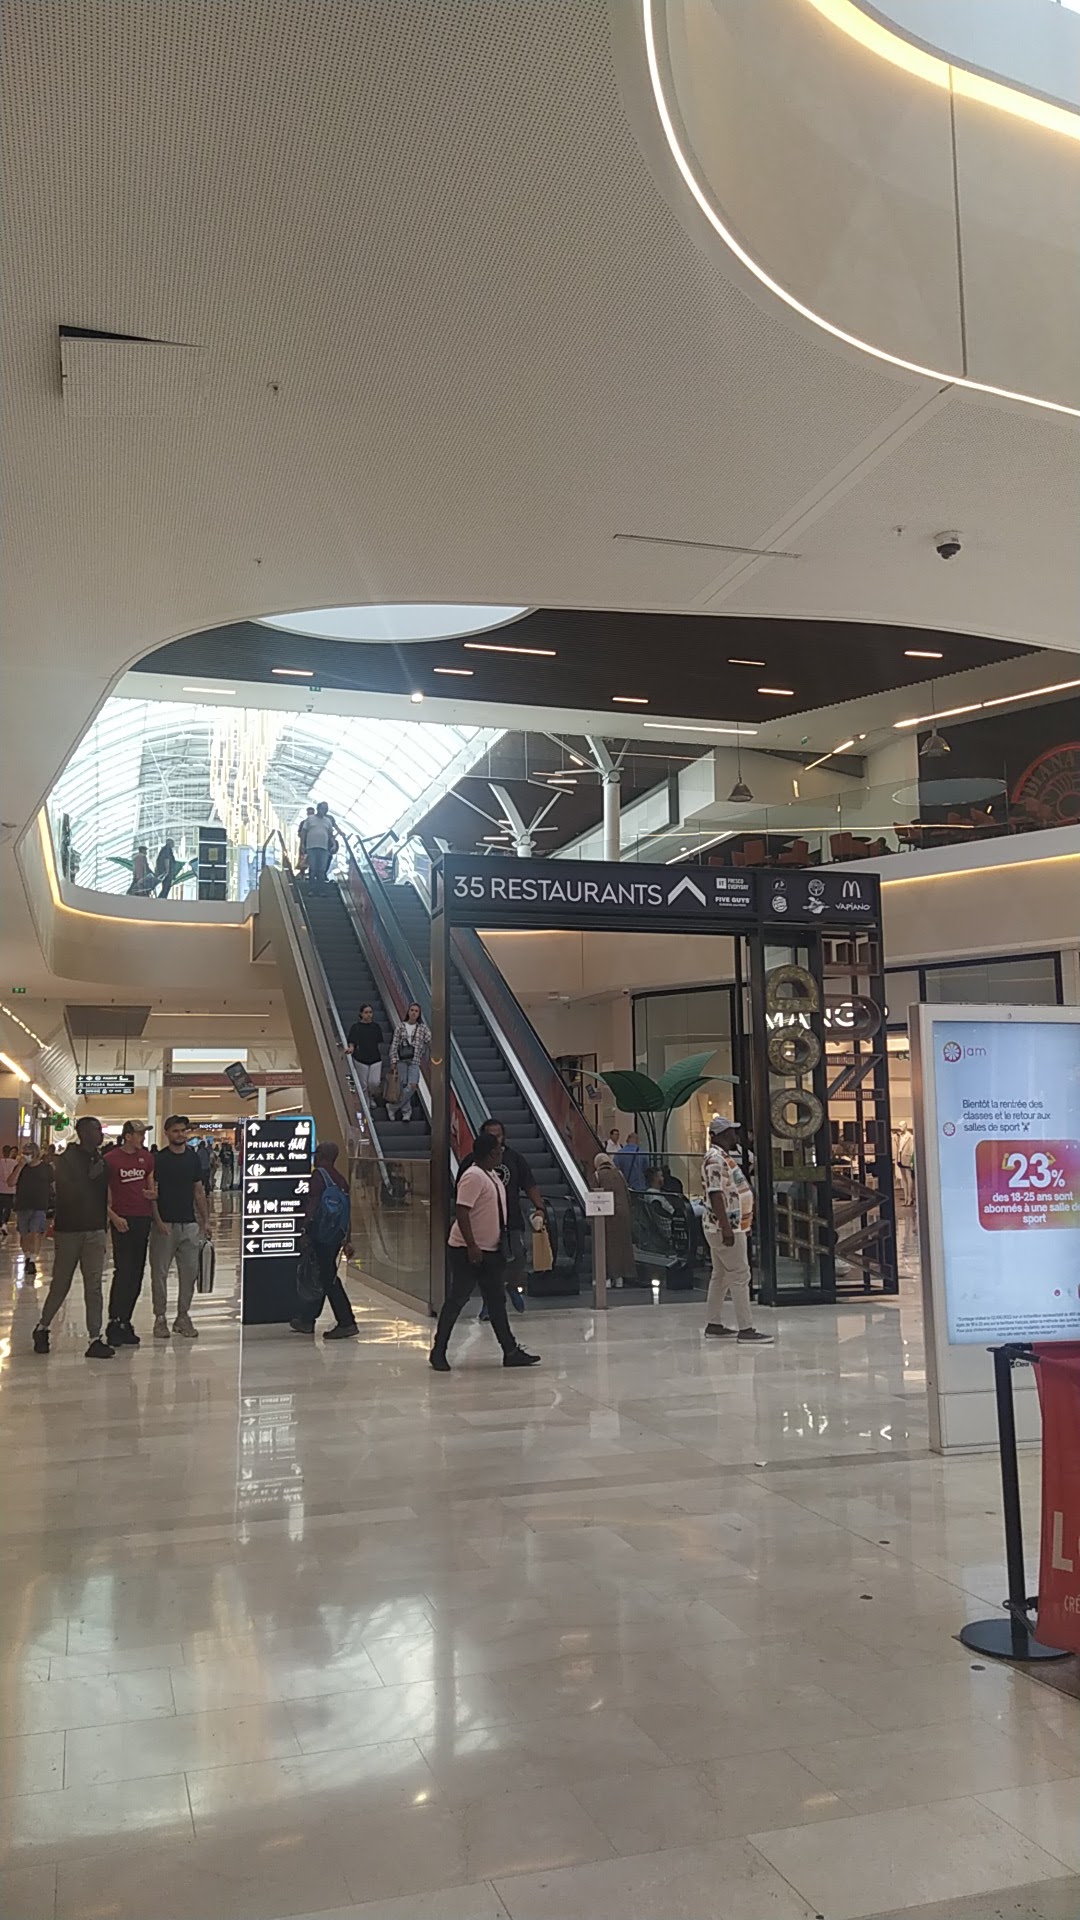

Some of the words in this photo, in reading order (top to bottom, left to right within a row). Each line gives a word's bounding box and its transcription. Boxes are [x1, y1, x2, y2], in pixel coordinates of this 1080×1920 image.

[453, 875, 485, 899] 35
[490, 876, 663, 906] RESTAURANTS
[835, 902, 871, 911] VAPIANO
[963, 1044, 987, 1058] jam
[962, 1099, 990, 1109] Bientôt
[991, 1100, 999, 1109] la
[1000, 1100, 1028, 1109] rentrée
[1028, 1100, 1044, 1109] des
[963, 1111, 994, 1120] classes
[995, 1111, 1003, 1120] et
[1004, 1111, 1012, 1120] le
[1012, 1111, 1036, 1120] retour
[1037, 1112, 1051, 1120] aux
[963, 1122, 987, 1131] salles
[987, 1122, 999, 1131] de
[1000, 1123, 1021, 1133] sport
[247, 1141, 286, 1149] PRIMARK
[120, 1168, 146, 1178] beko
[1007, 1152, 1066, 1188] 23%
[992, 1193, 1009, 1202] des
[1010, 1192, 1035, 1202] 18-25
[1036, 1193, 1053, 1201] ans
[1054, 1192, 1074, 1201] sont
[983, 1204, 1022, 1213] abonnés
[1024, 1203, 1030, 1212] à
[1031, 1204, 1048, 1212] une
[1049, 1202, 1070, 1212] salle
[1022, 1213, 1047, 1224] sport
[1052, 1511, 1080, 1573] L
